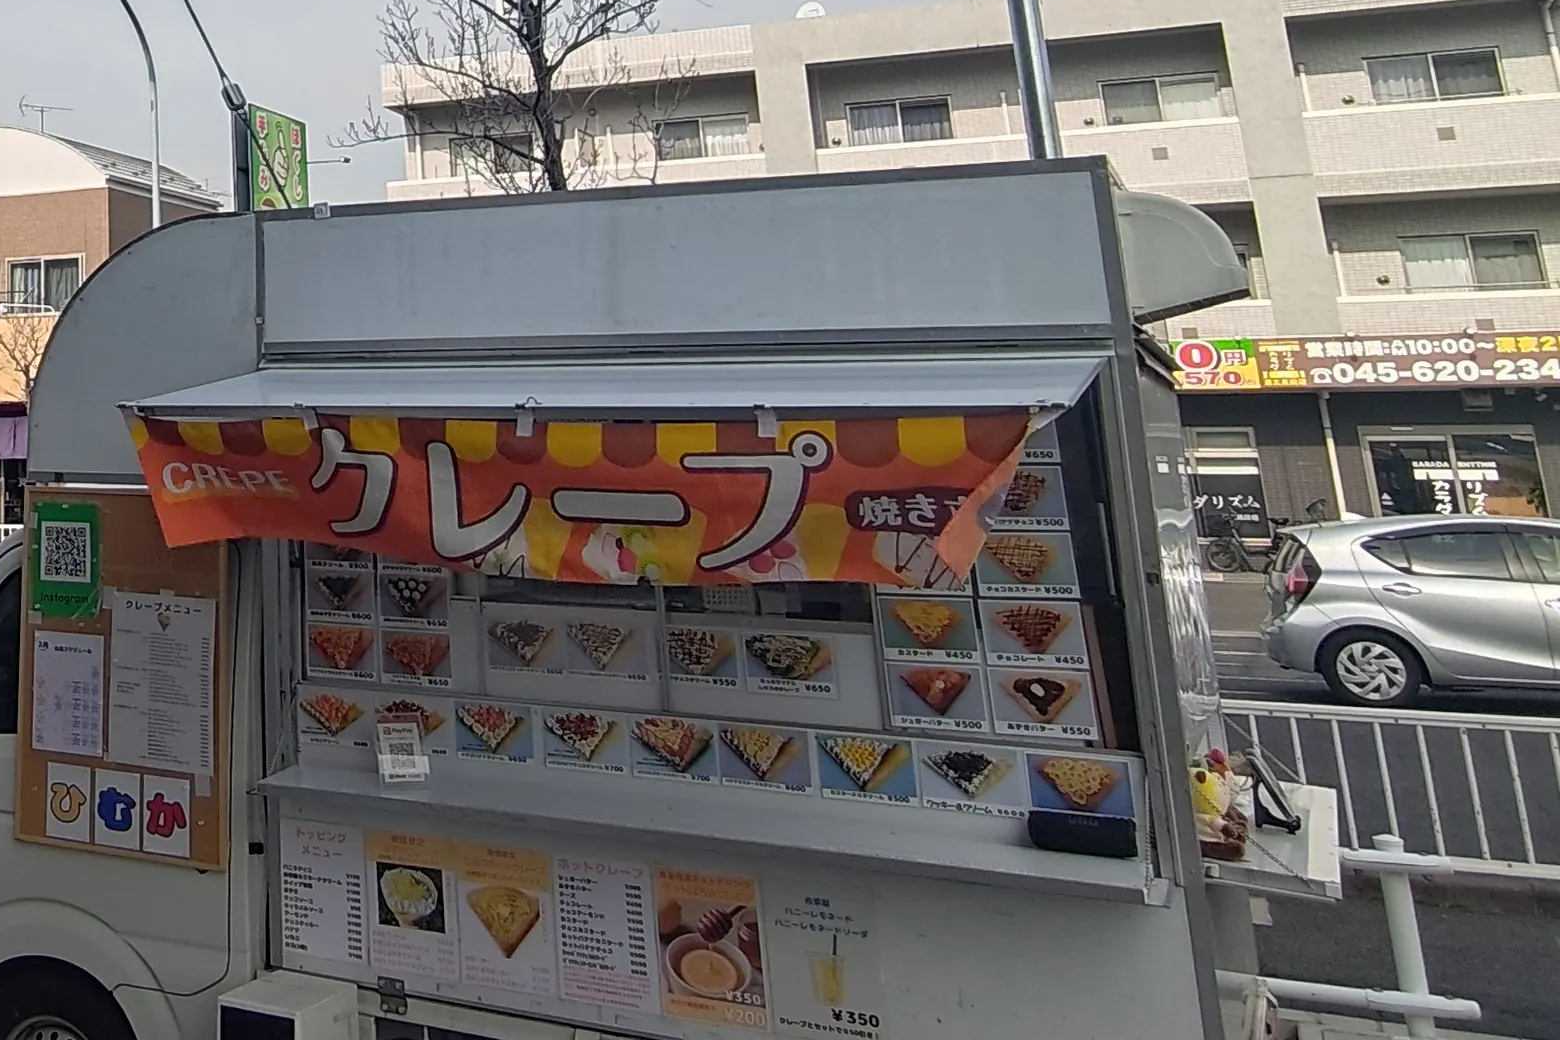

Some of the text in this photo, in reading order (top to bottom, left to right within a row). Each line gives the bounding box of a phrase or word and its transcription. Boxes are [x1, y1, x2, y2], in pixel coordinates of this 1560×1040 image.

[161, 461, 295, 496] CREPE
[309, 427, 835, 573] クレープ
[1193, 494, 1261, 509] ダリズム
[125, 600, 202, 615] クレープメニュー
[898, 649, 934, 657] カスタード
[996, 654, 1045, 663] チョコレート
[296, 828, 347, 844] トッピング
[302, 845, 344, 858] メニュー
[557, 858, 643, 879] ホットクレープ
[724, 1008, 766, 1027] ¥200
[831, 1008, 880, 1028] ¥350
